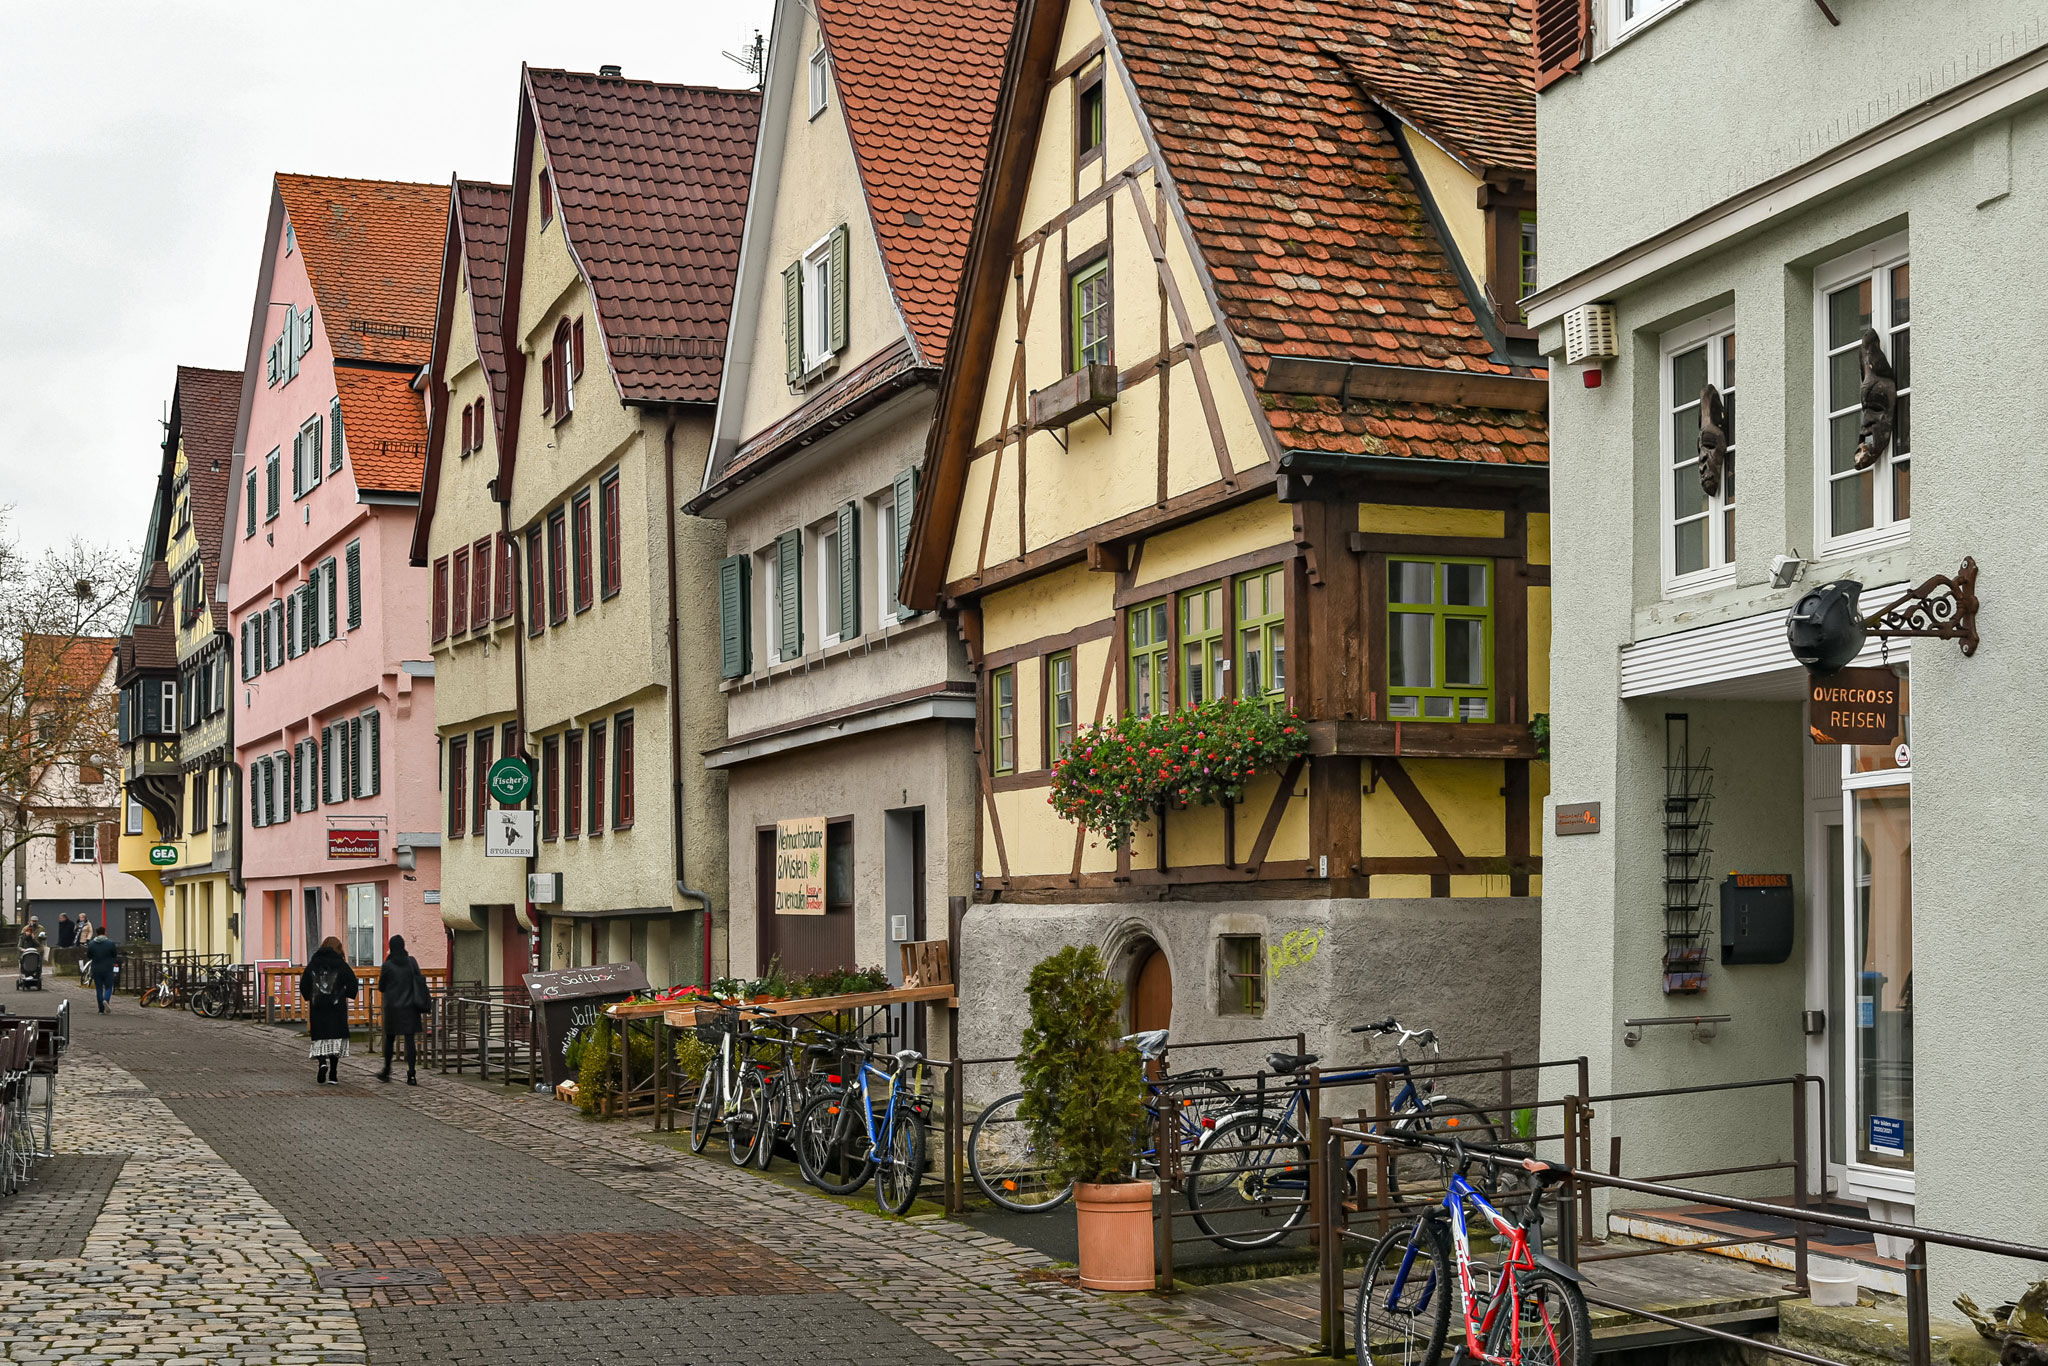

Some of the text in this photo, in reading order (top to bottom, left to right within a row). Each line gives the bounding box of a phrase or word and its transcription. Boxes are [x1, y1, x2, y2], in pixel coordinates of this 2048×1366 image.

[1813, 686, 1894, 704] OVERCROSS
[1831, 710, 1886, 729] REISEN
[492, 775, 529, 787] Fischer's
[1583, 810, 1597, 825] 9a
[152, 849, 176, 859] GEA
[1736, 875, 1788, 887] OVERCROSS
[560, 974, 616, 985] Saftbox
